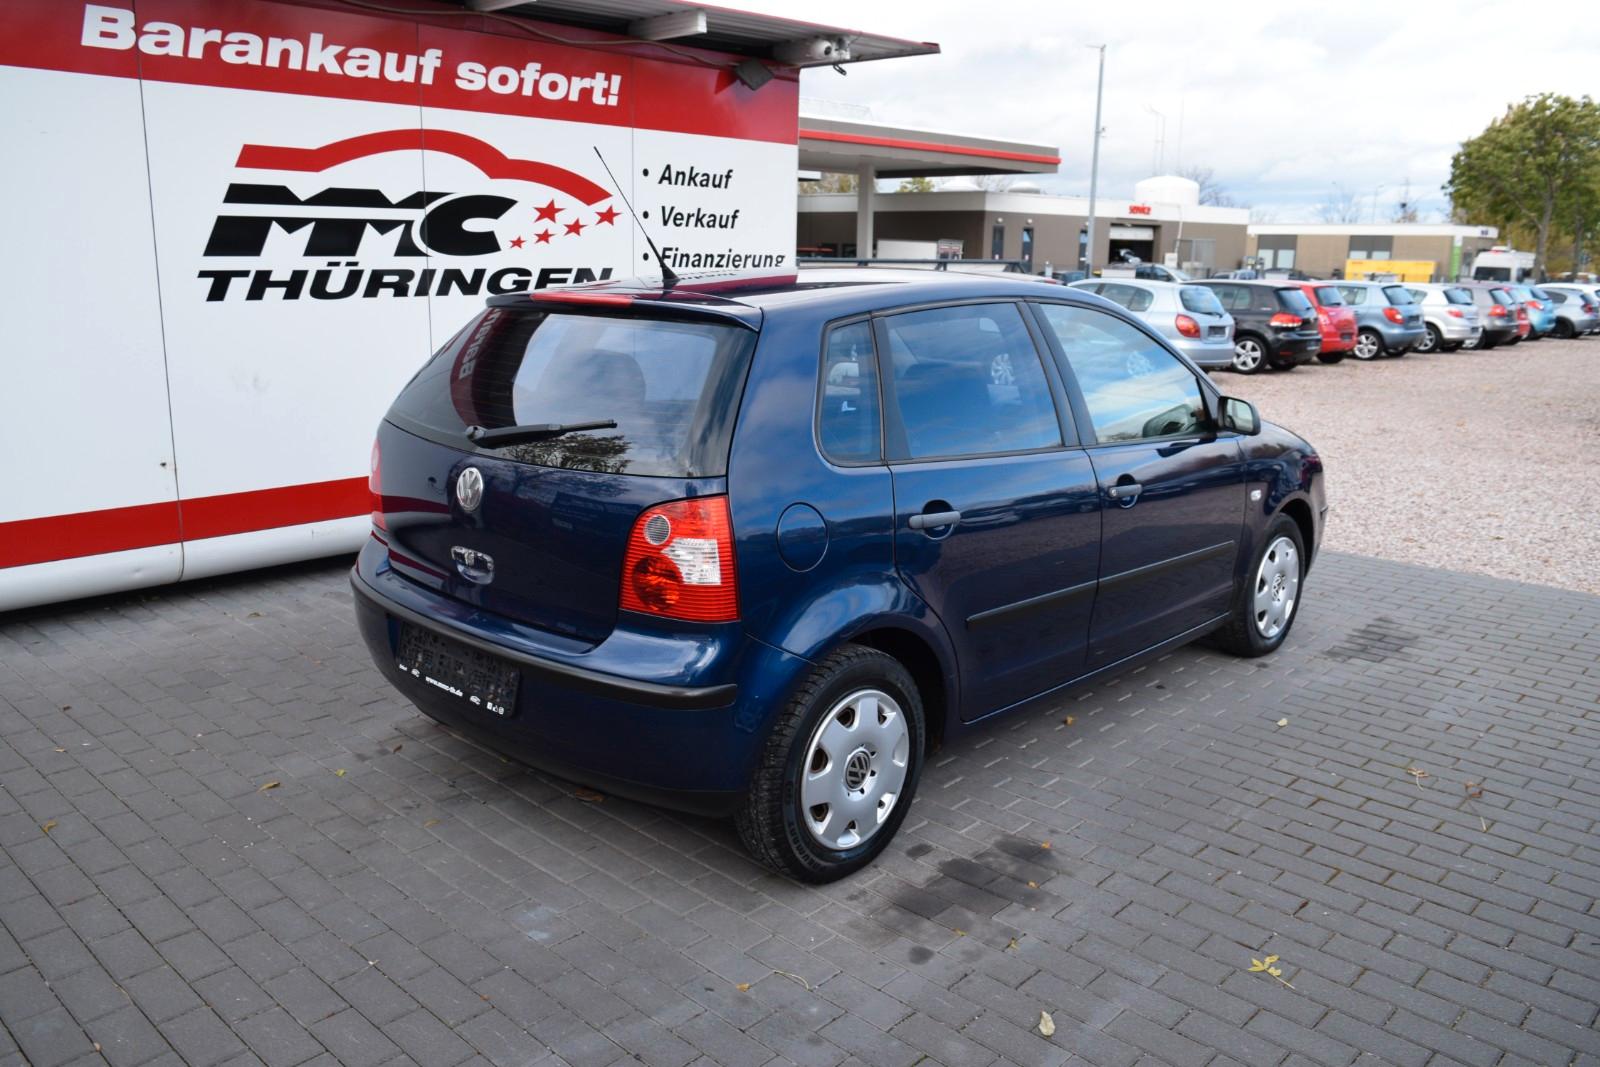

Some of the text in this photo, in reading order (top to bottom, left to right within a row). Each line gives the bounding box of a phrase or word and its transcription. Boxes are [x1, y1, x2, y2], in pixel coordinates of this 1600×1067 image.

[81, 4, 621, 106] Barankauf sofort!
[658, 164, 733, 189] Ankauf
[661, 205, 740, 229] Verkauf
[660, 247, 786, 269] Finanzierung
